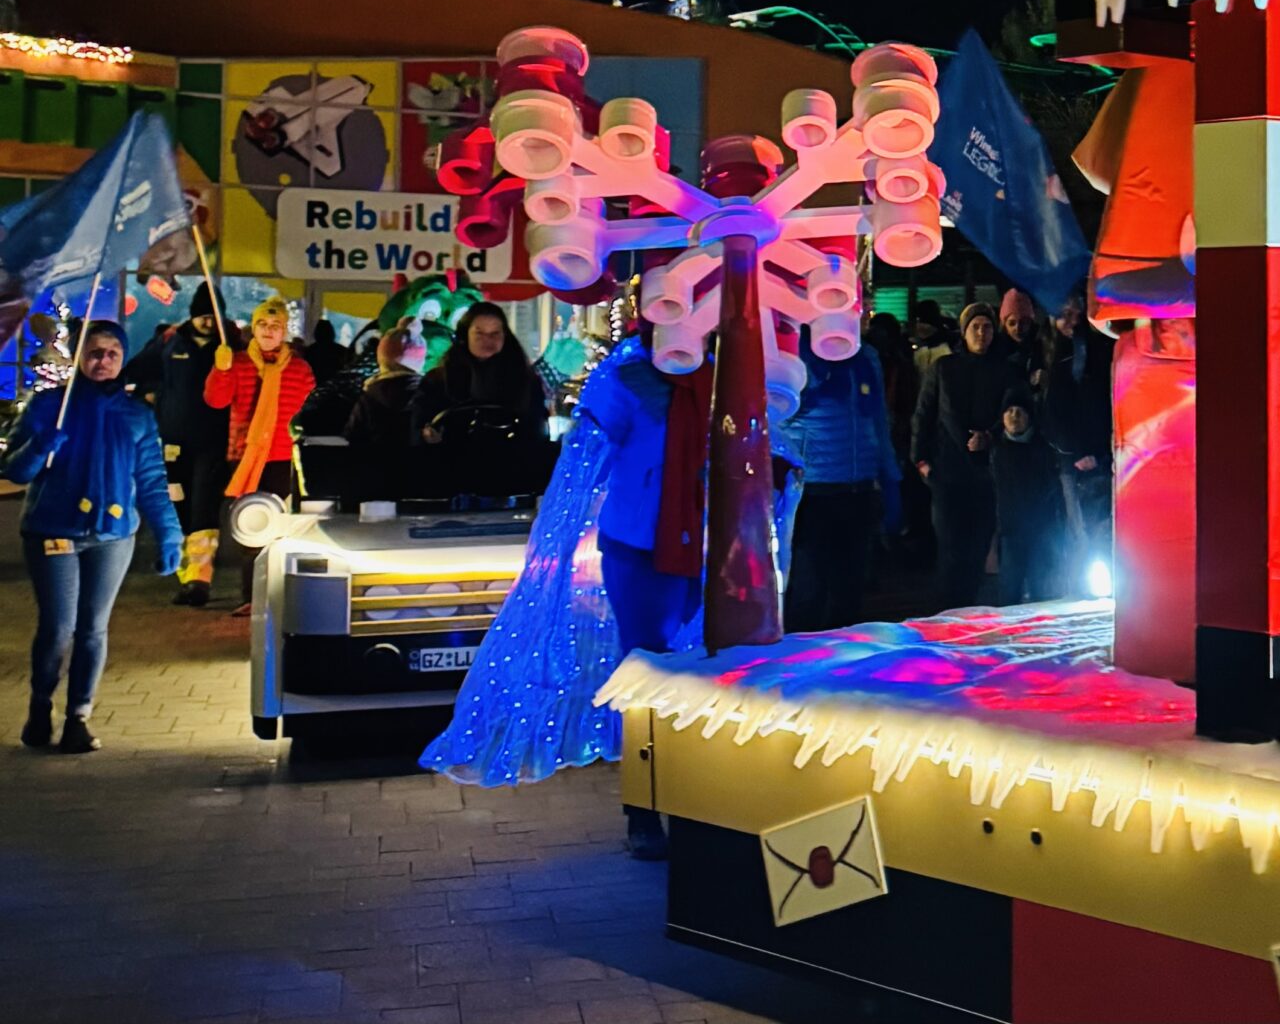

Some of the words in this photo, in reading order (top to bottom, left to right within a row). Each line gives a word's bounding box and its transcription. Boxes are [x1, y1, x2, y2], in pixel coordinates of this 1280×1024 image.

[306, 200, 451, 232] Rebuild
[306, 240, 368, 269] the
[376, 243, 487, 272] World
